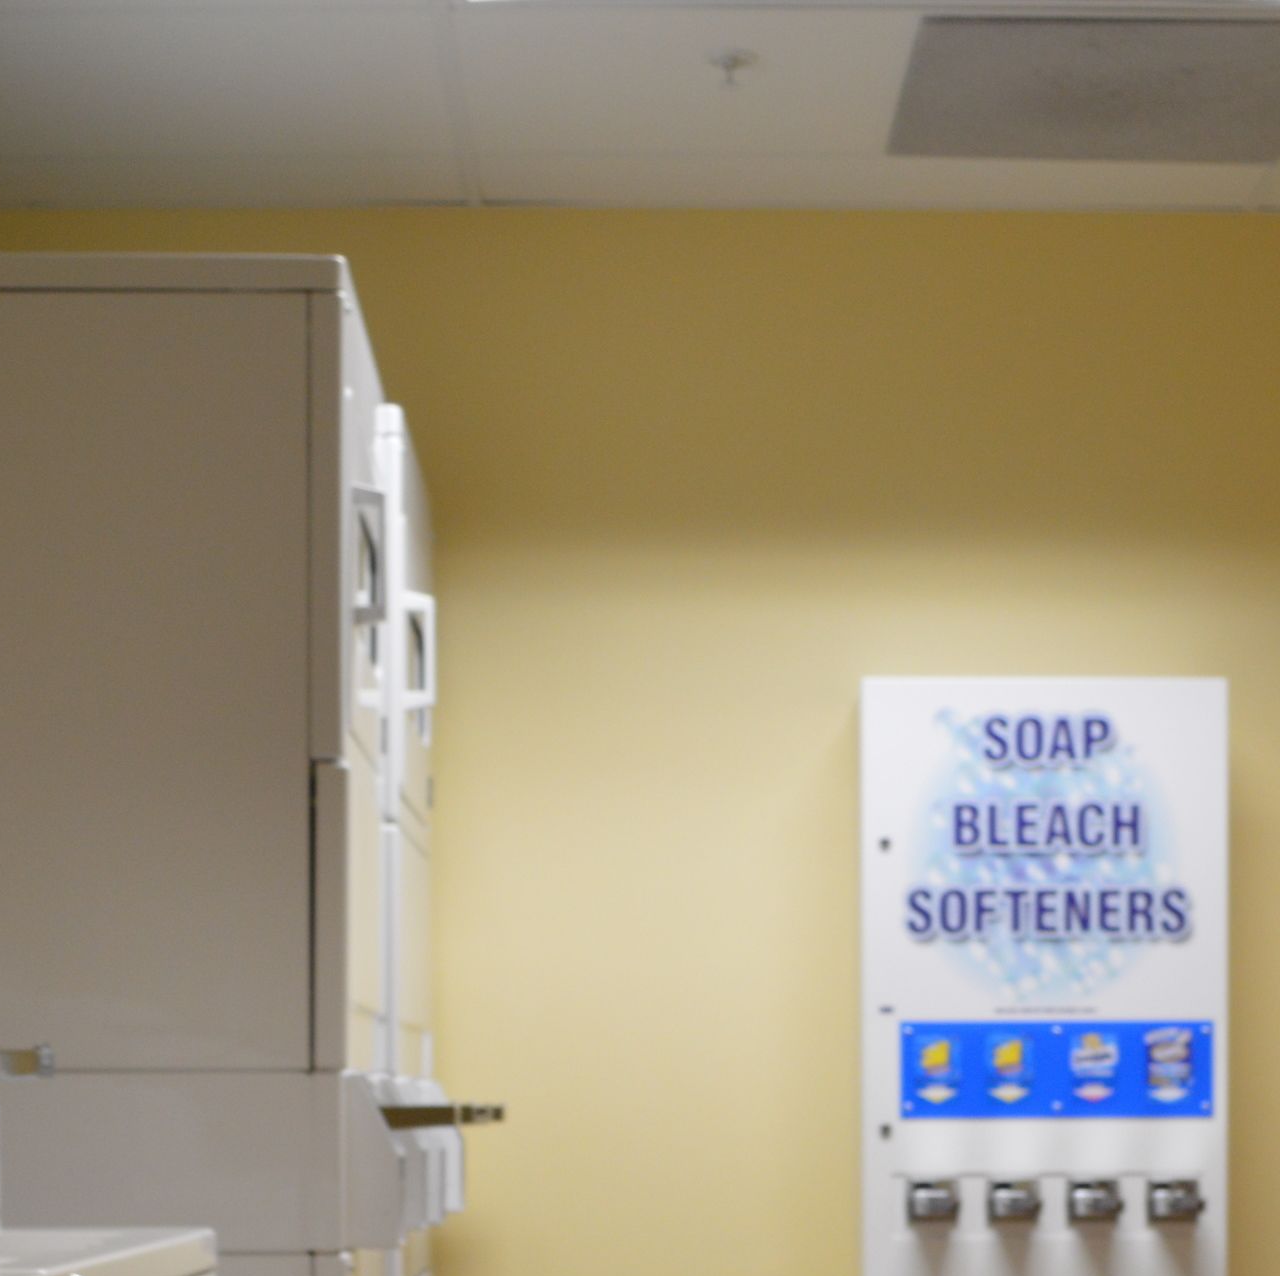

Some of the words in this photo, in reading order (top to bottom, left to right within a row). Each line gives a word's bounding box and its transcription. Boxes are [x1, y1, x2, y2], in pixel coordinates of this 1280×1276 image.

[982, 716, 1113, 763] SOAP
[952, 802, 1142, 850] BLEACH
[905, 887, 1189, 936] SOFTENERS
